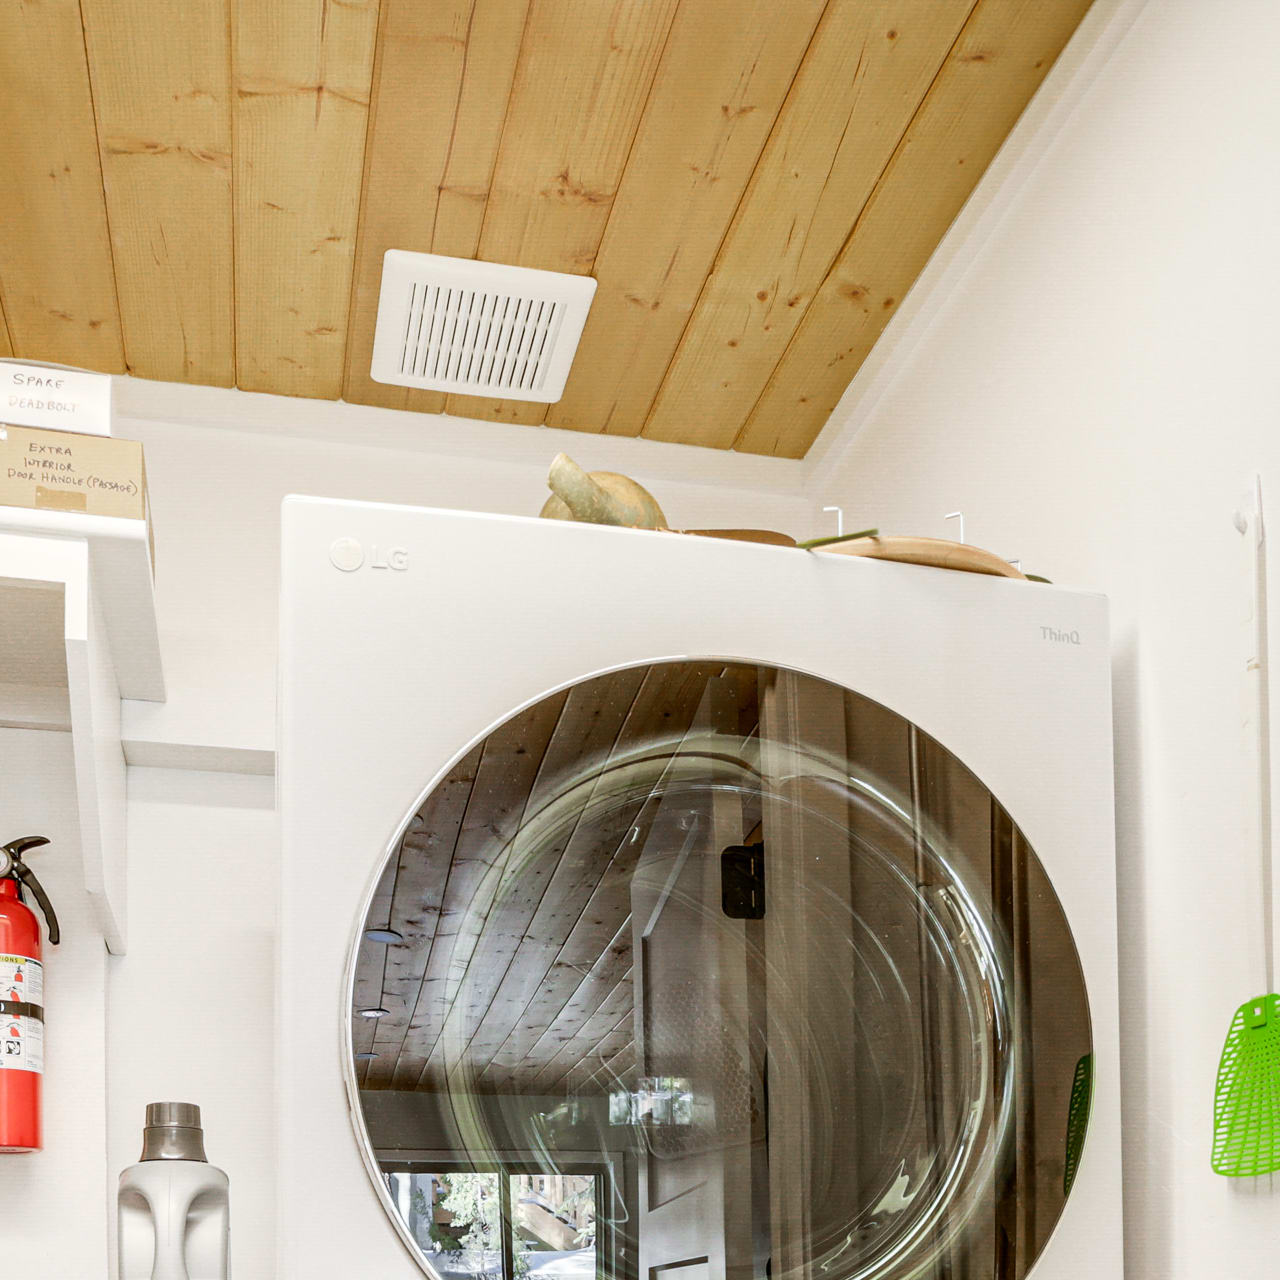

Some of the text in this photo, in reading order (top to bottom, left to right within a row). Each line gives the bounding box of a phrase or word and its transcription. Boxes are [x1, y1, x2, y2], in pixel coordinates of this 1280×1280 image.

[13, 373, 64, 389] SPARE
[29, 443, 72, 456] EXTRA
[8, 468, 36, 480] DOOR
[42, 474, 84, 487] HANDLE
[371, 546, 408, 571] LG
[1039, 626, 1081, 645] ThinQ
